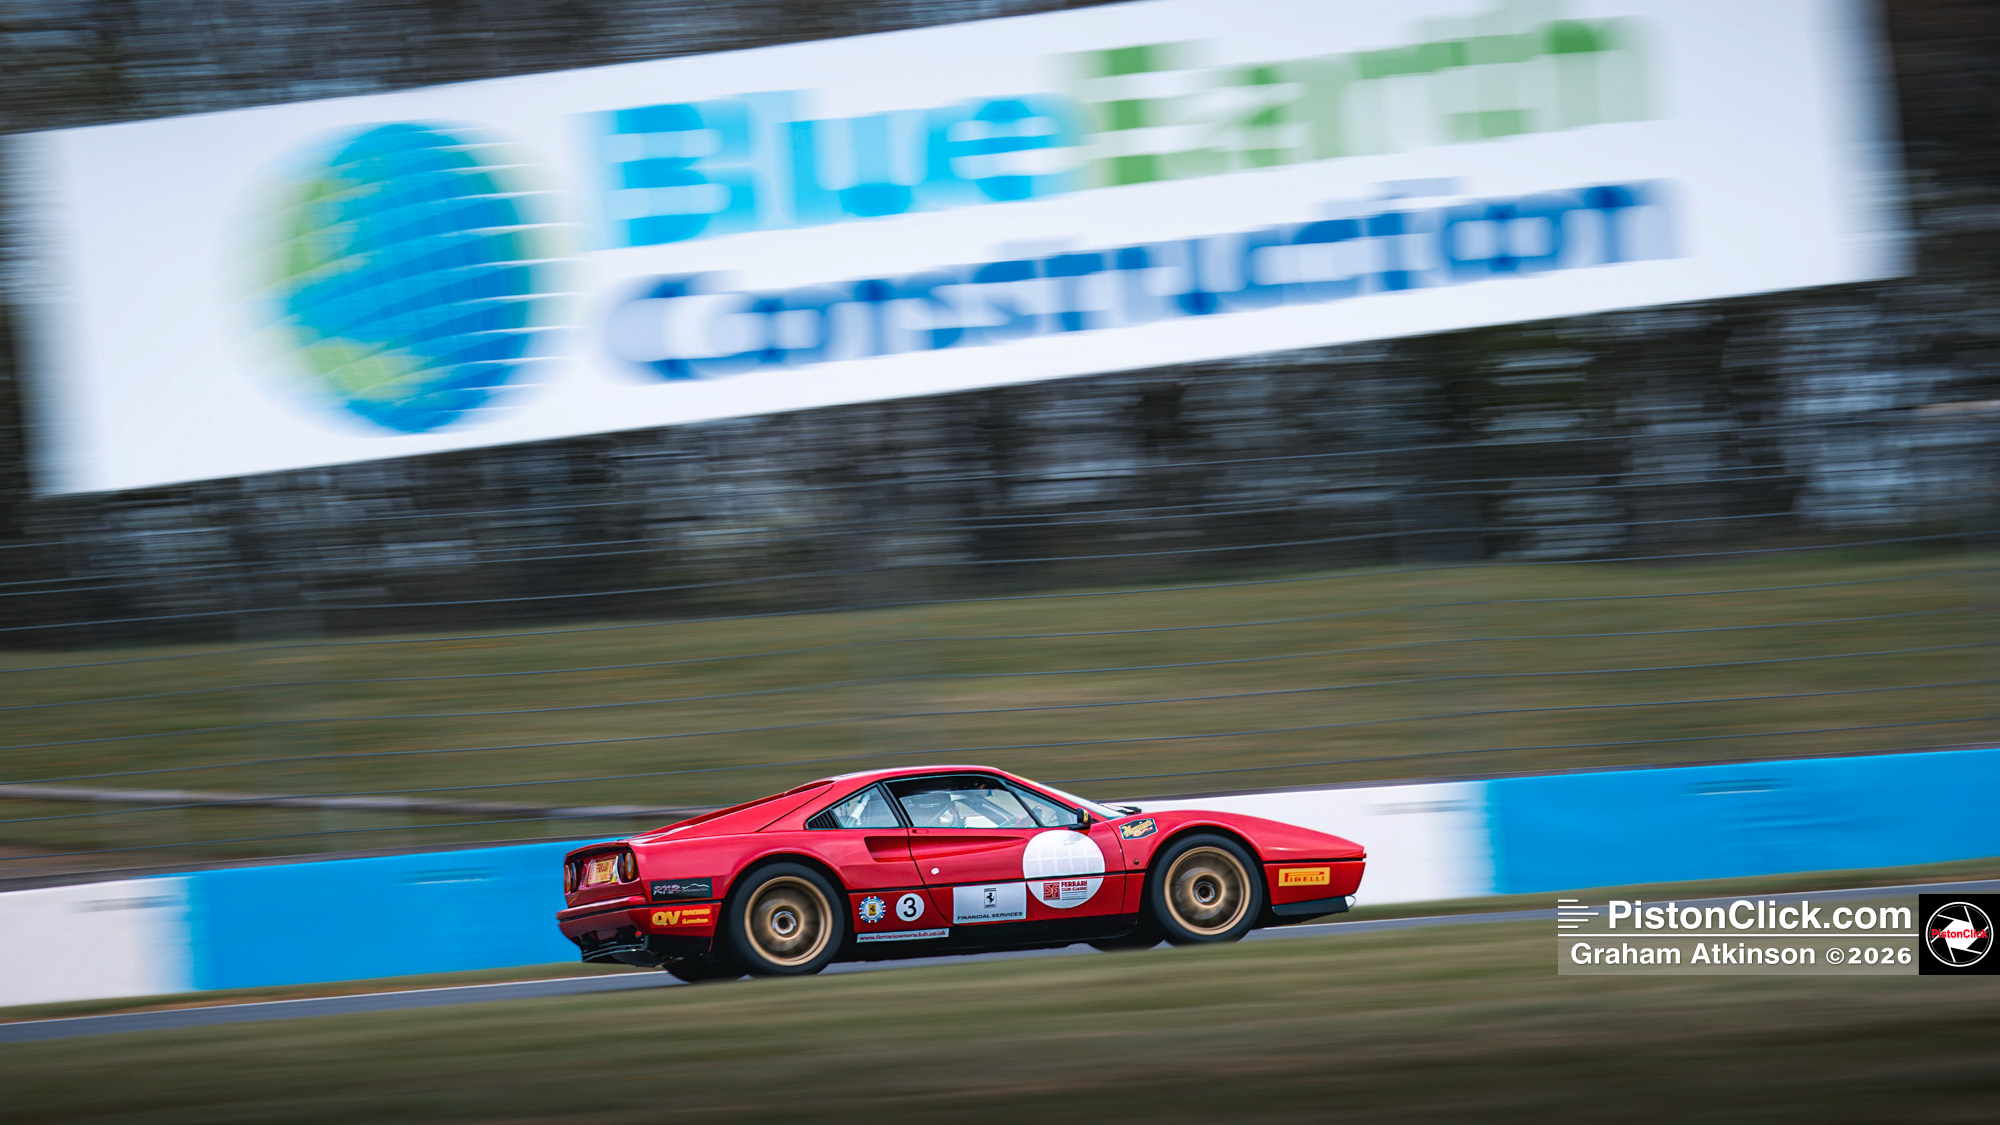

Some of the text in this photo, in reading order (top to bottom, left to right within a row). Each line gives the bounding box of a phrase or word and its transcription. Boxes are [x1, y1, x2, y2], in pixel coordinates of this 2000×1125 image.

[605, 177, 1690, 386] Construction
[1061, 880, 1088, 888] FERRARI
[1284, 871, 1325, 883] PIRELLI
[903, 897, 917, 917] 3
[652, 910, 682, 926] QV
[860, 930, 946, 941] www.ferrariownersclub.co.uk
